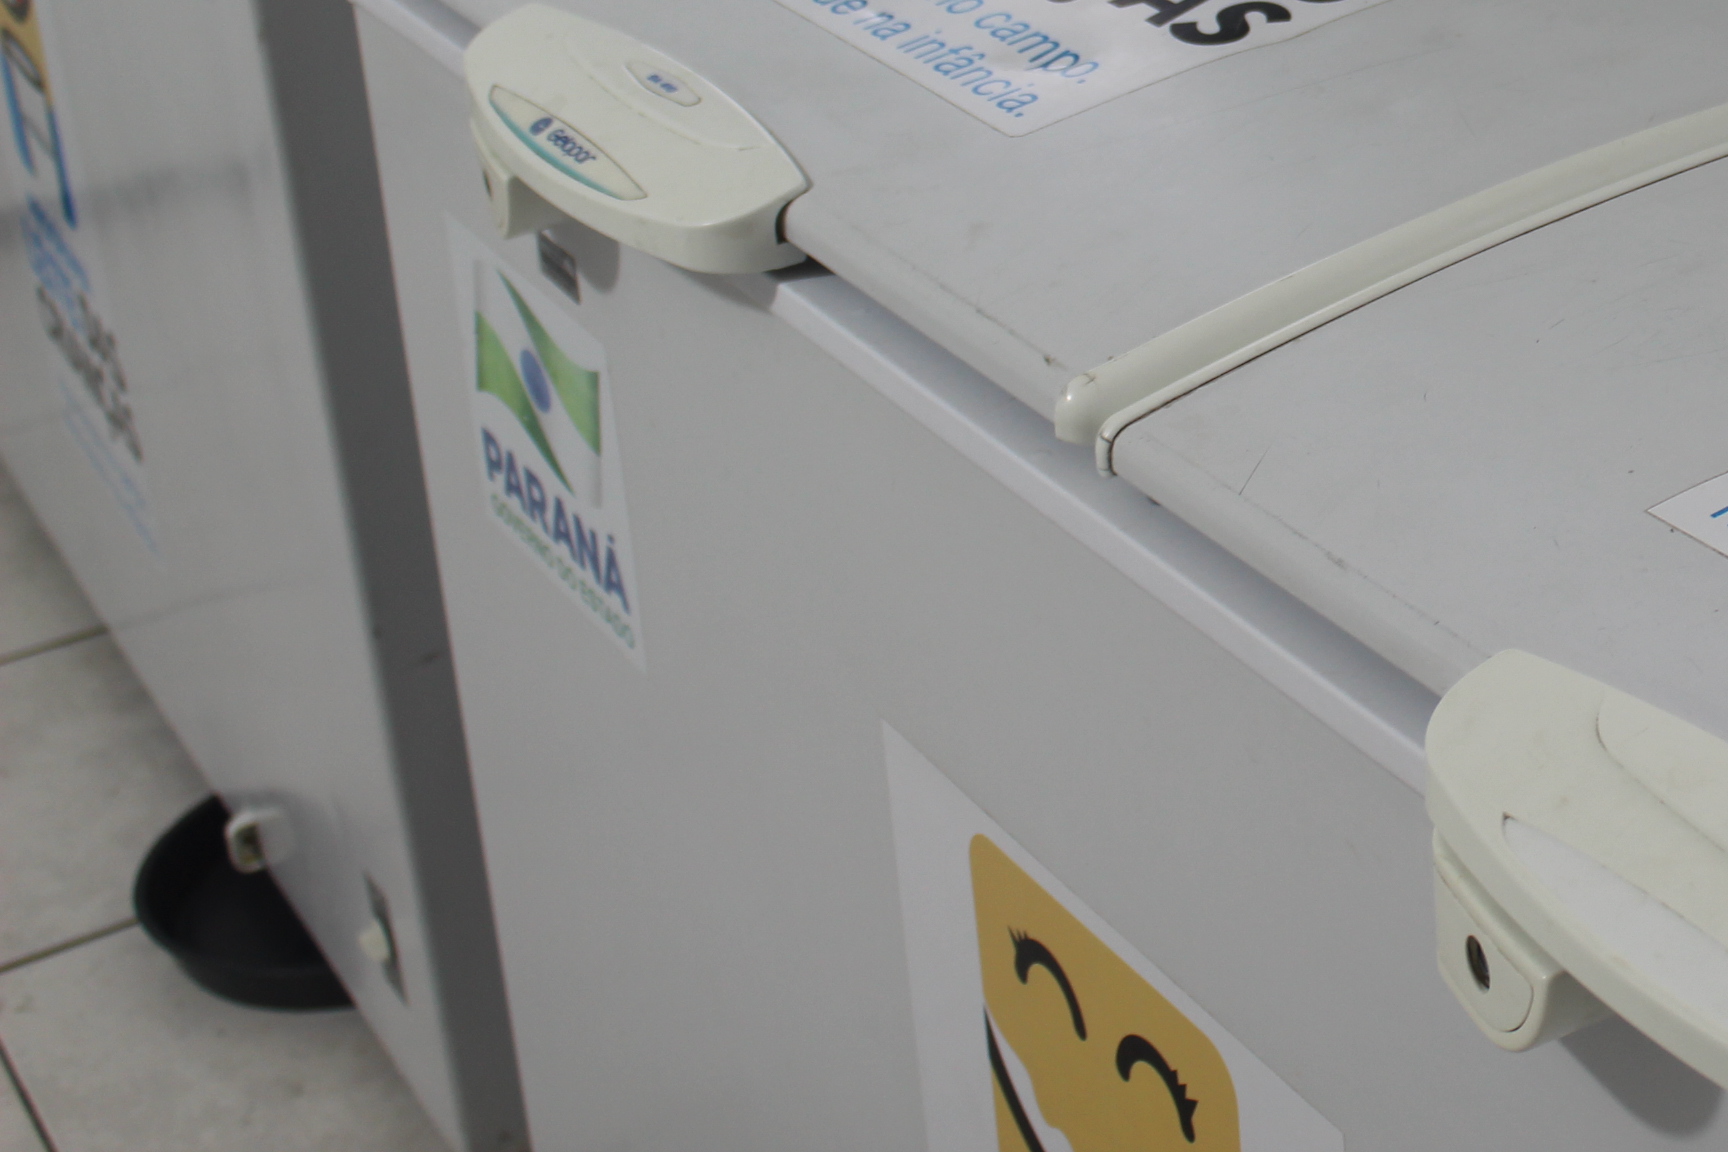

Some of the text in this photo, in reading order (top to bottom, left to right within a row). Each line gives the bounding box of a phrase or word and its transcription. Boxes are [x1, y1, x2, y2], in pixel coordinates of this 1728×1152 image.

[855, 6, 911, 42] na
[896, 28, 1040, 119] infância.
[981, 10, 1101, 85] campo.
[481, 427, 631, 615] PARANÁ
